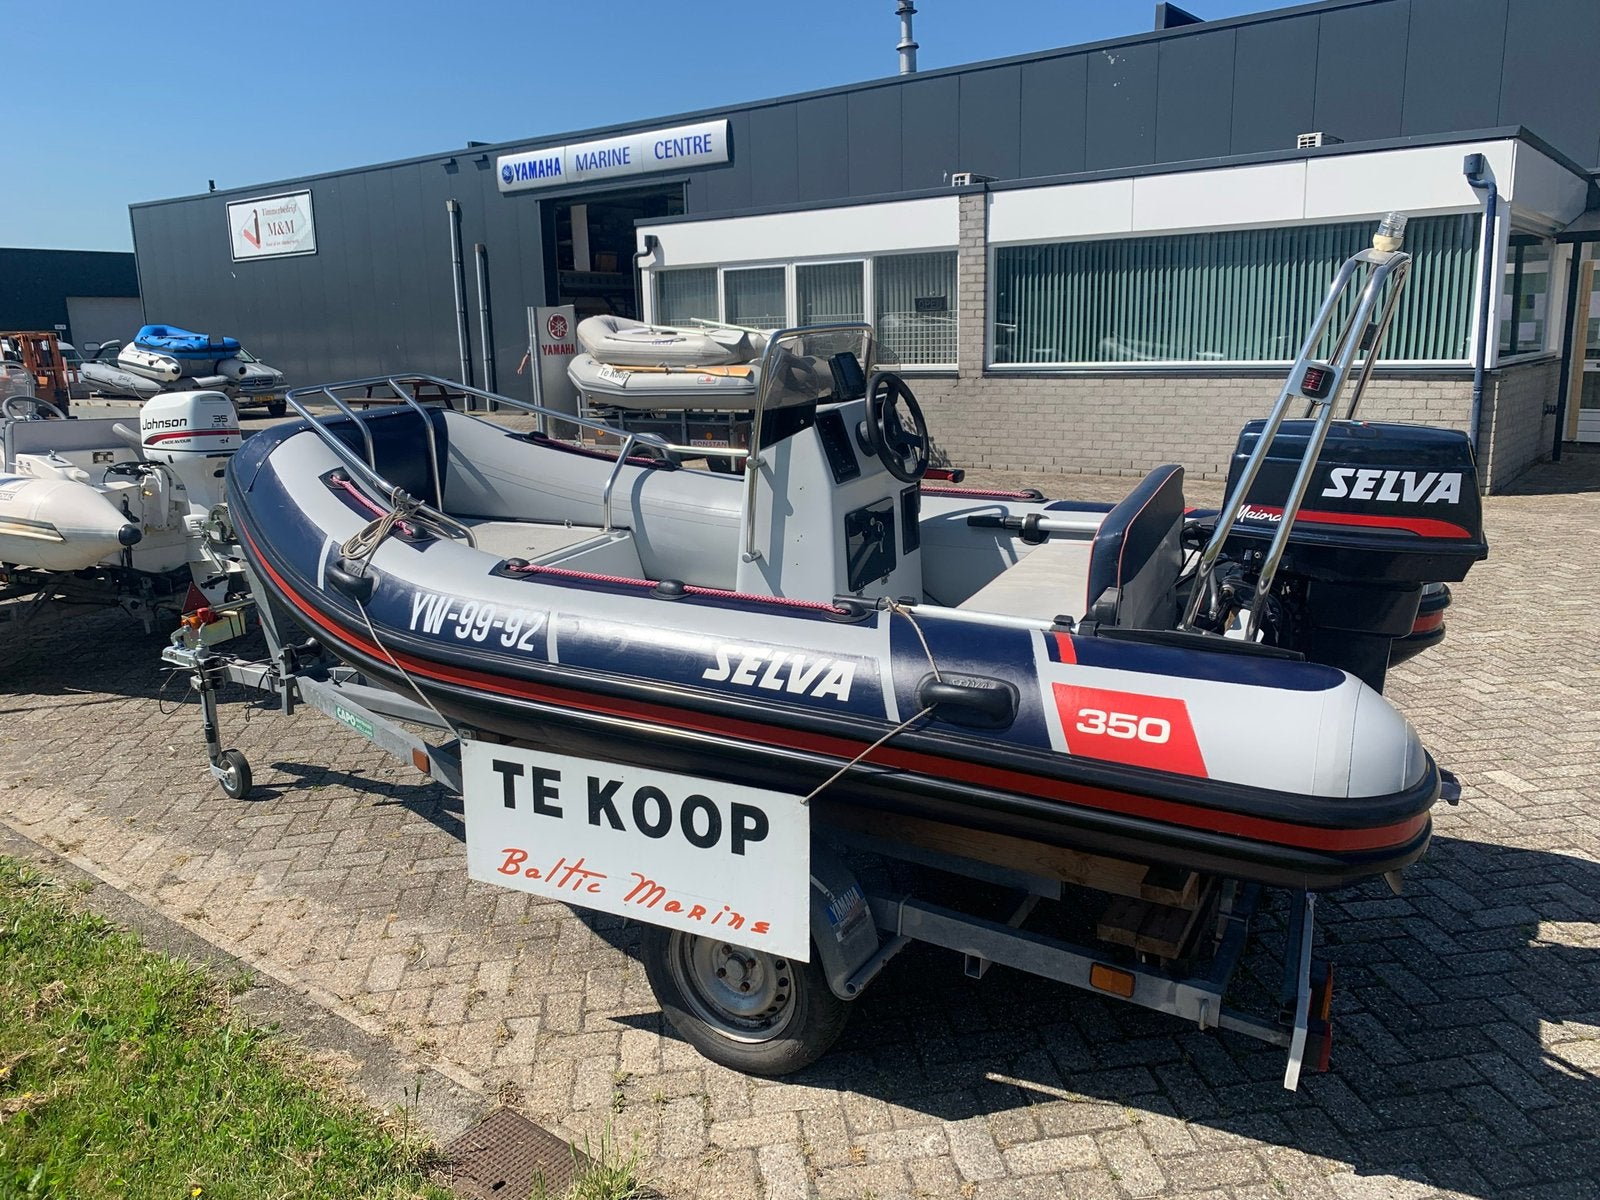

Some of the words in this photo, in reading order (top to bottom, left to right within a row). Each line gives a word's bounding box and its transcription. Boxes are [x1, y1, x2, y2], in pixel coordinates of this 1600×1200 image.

[513, 157, 562, 181] YAMAHA
[575, 146, 631, 171] MARINE
[654, 134, 712, 159] CENTRE
[268, 220, 294, 236] M&M
[541, 344, 576, 355] YAMAHA
[143, 418, 187, 430] Johnson
[212, 415, 228, 423] 35
[1322, 467, 1462, 504] SELVA
[409, 592, 546, 652] YW-99-92
[702, 644, 856, 701] SELVA
[337, 707, 356, 727] CAPO
[1076, 708, 1171, 744] 350
[492, 759, 564, 819] TE
[587, 776, 769, 856] KOOP
[497, 847, 608, 894] Baltic
